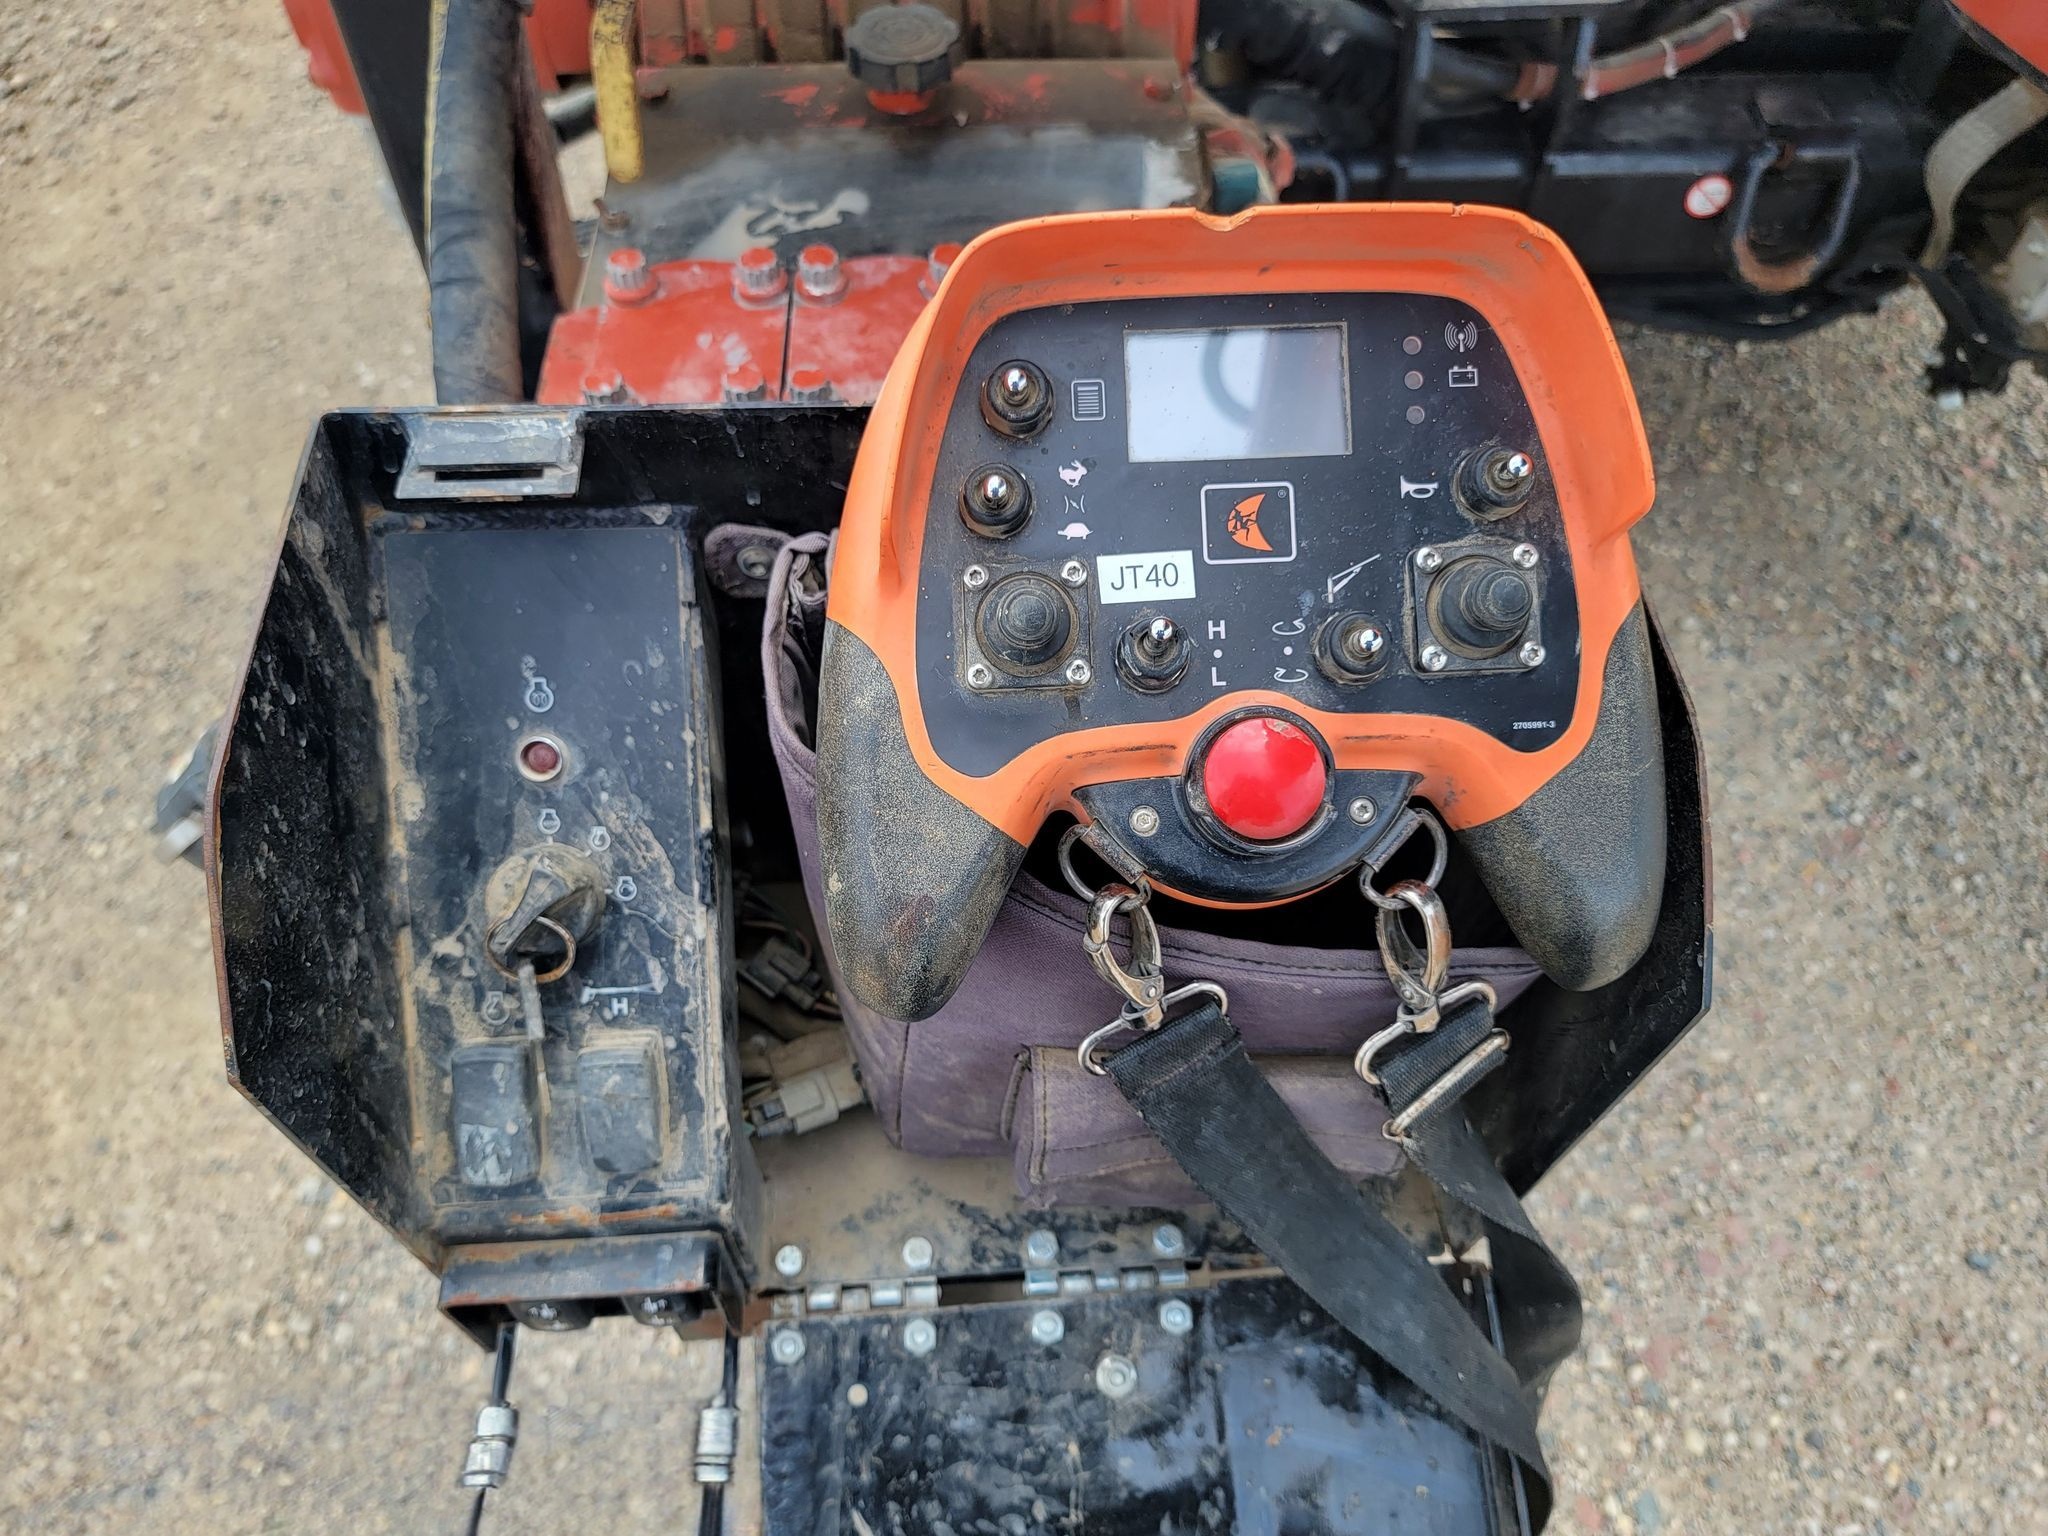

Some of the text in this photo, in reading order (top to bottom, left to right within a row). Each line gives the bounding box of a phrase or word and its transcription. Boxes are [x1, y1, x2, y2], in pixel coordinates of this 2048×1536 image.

[1111, 562, 1179, 591] JT40
[1207, 620, 1226, 640] H
[1211, 667, 1227, 687] L
[1512, 720, 1557, 730] 2705991-3
[611, 997, 628, 1016] H
